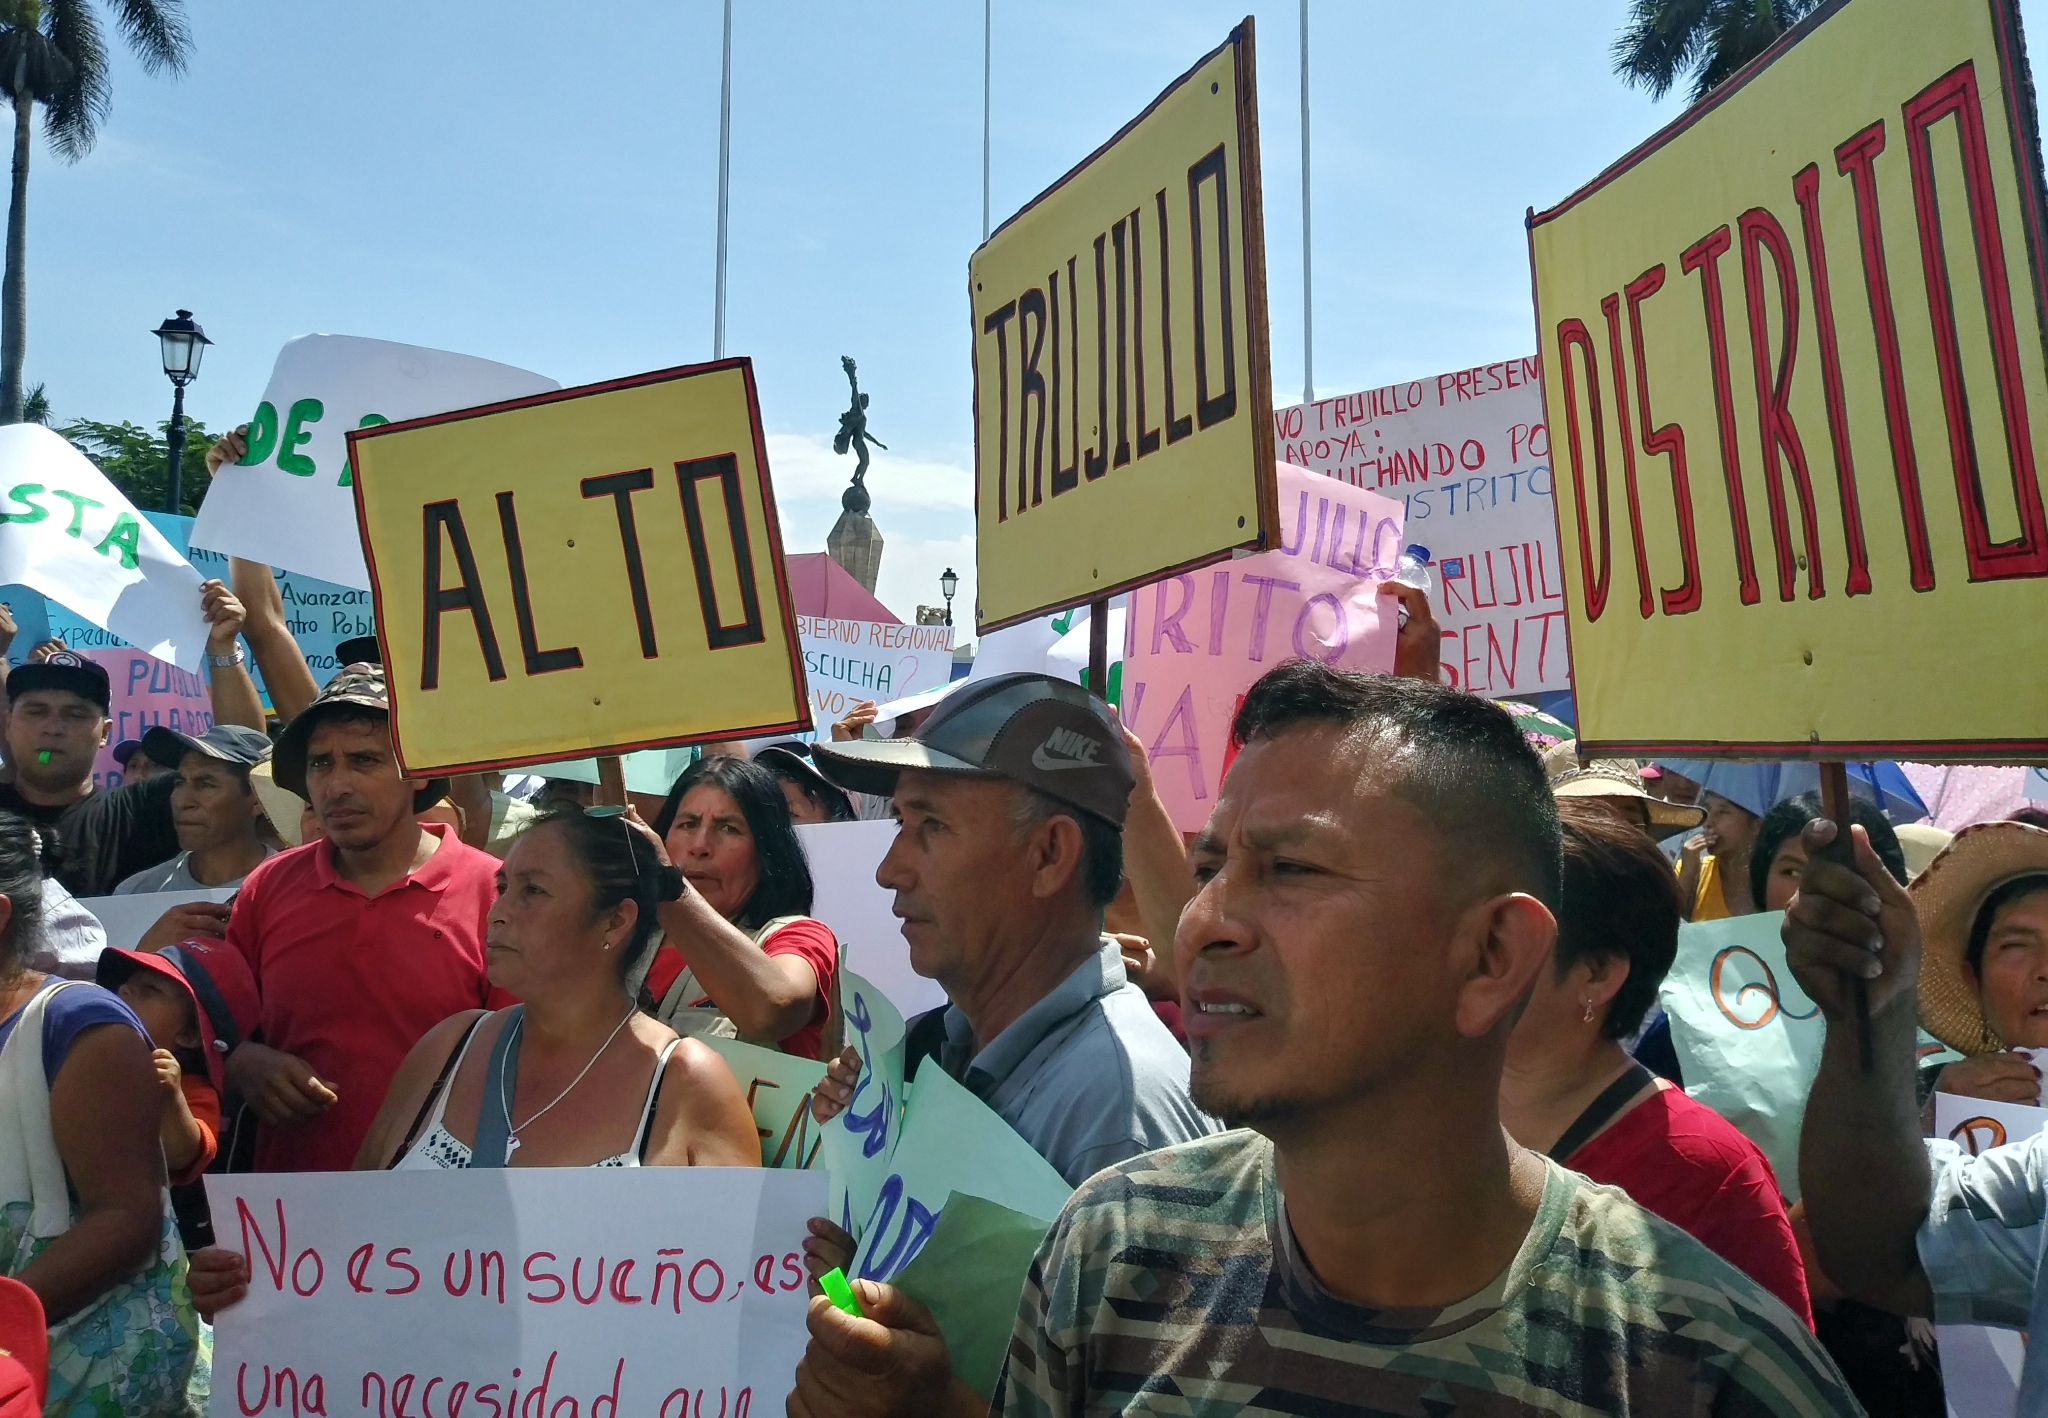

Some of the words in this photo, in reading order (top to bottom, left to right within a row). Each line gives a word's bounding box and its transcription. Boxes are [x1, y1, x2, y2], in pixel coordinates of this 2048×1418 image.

[984, 142, 1238, 523] TRUJILLO
[1557, 59, 2048, 623] DISTRITO
[1311, 381, 1422, 431] TRUJILLO
[1326, 439, 1485, 492] UCHANDO
[1393, 465, 1551, 522] ISTRITO
[0, 482, 140, 570] STA
[420, 452, 766, 692] ALTO
[331, 611, 376, 636] Pobl
[869, 623, 953, 652] REGIONAL
[1440, 610, 1571, 693] SENT
[1045, 726, 1102, 764] NIKE
[236, 1196, 323, 1297] No
[347, 1243, 420, 1295] es
[444, 1249, 505, 1304] un
[753, 1252, 804, 1295] es
[237, 1362, 327, 1418] una
